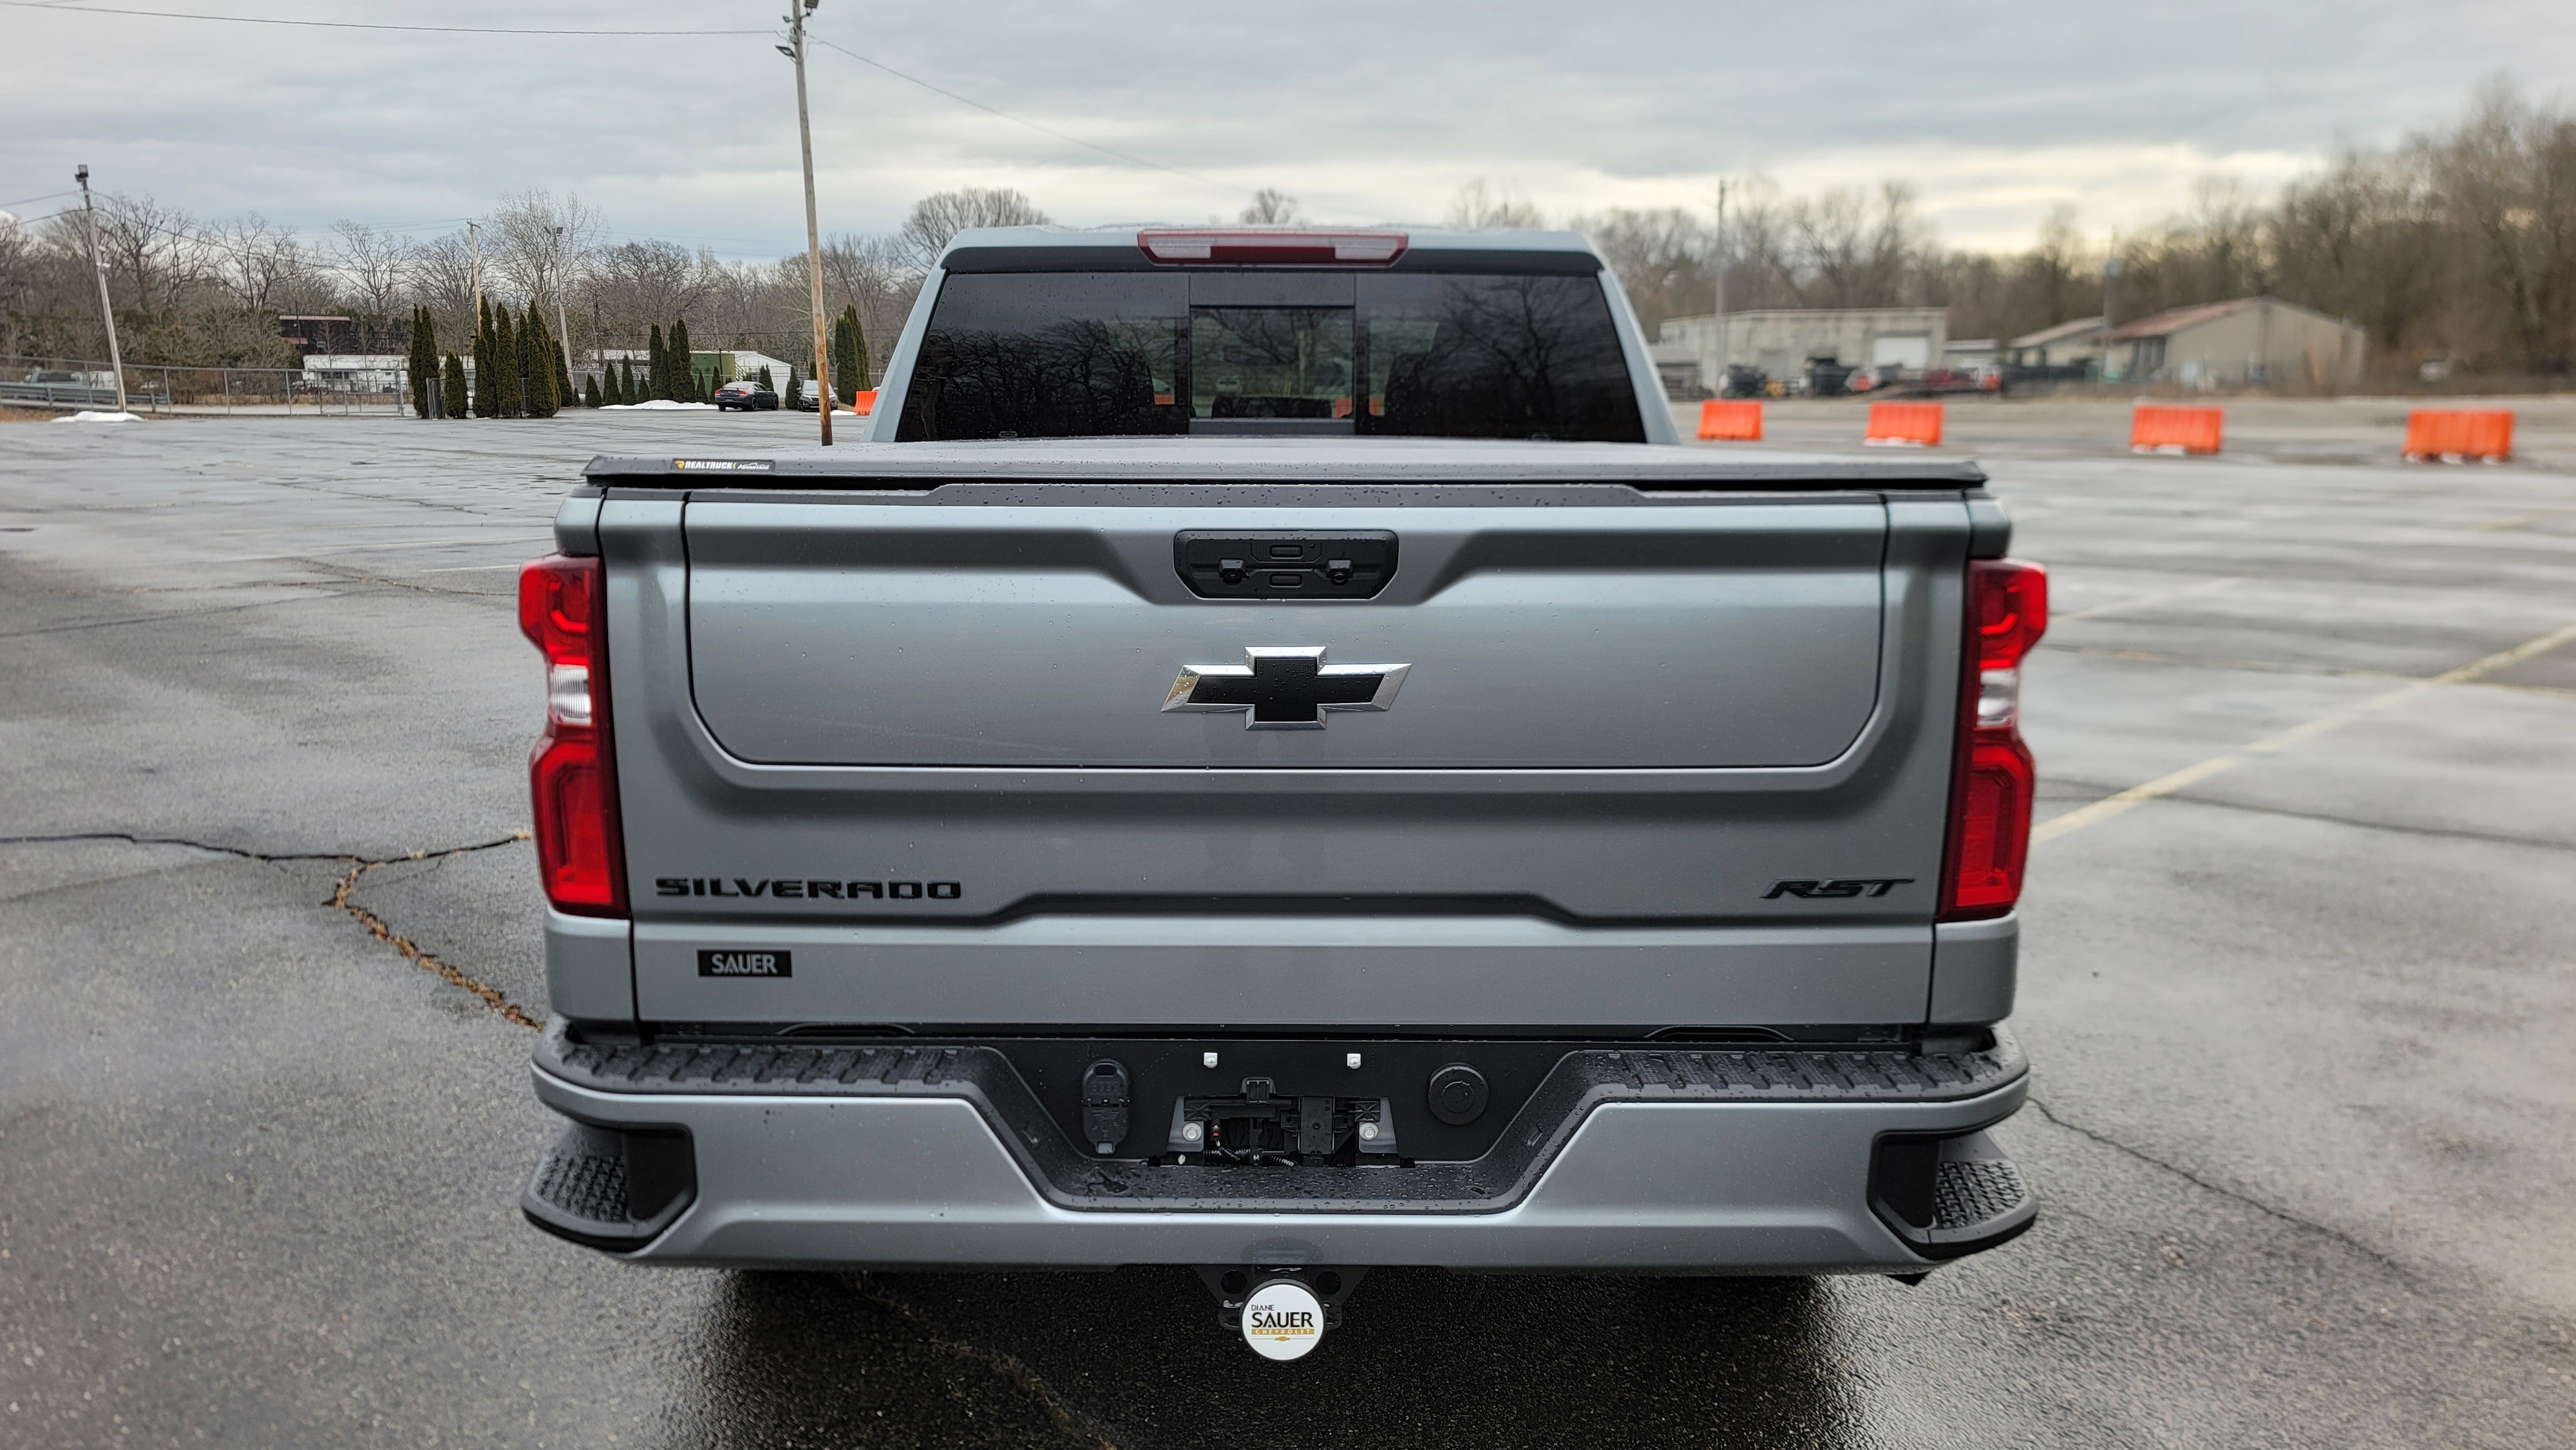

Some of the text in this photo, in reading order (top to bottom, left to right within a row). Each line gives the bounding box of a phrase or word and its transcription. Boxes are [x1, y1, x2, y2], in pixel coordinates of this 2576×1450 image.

[685, 460, 733, 469] REALTRUCK
[655, 878, 961, 899] SILVERADO
[1759, 878, 1915, 899] RST
[711, 953, 777, 975] SAUER
[1251, 1312, 1314, 1328] SAUER
